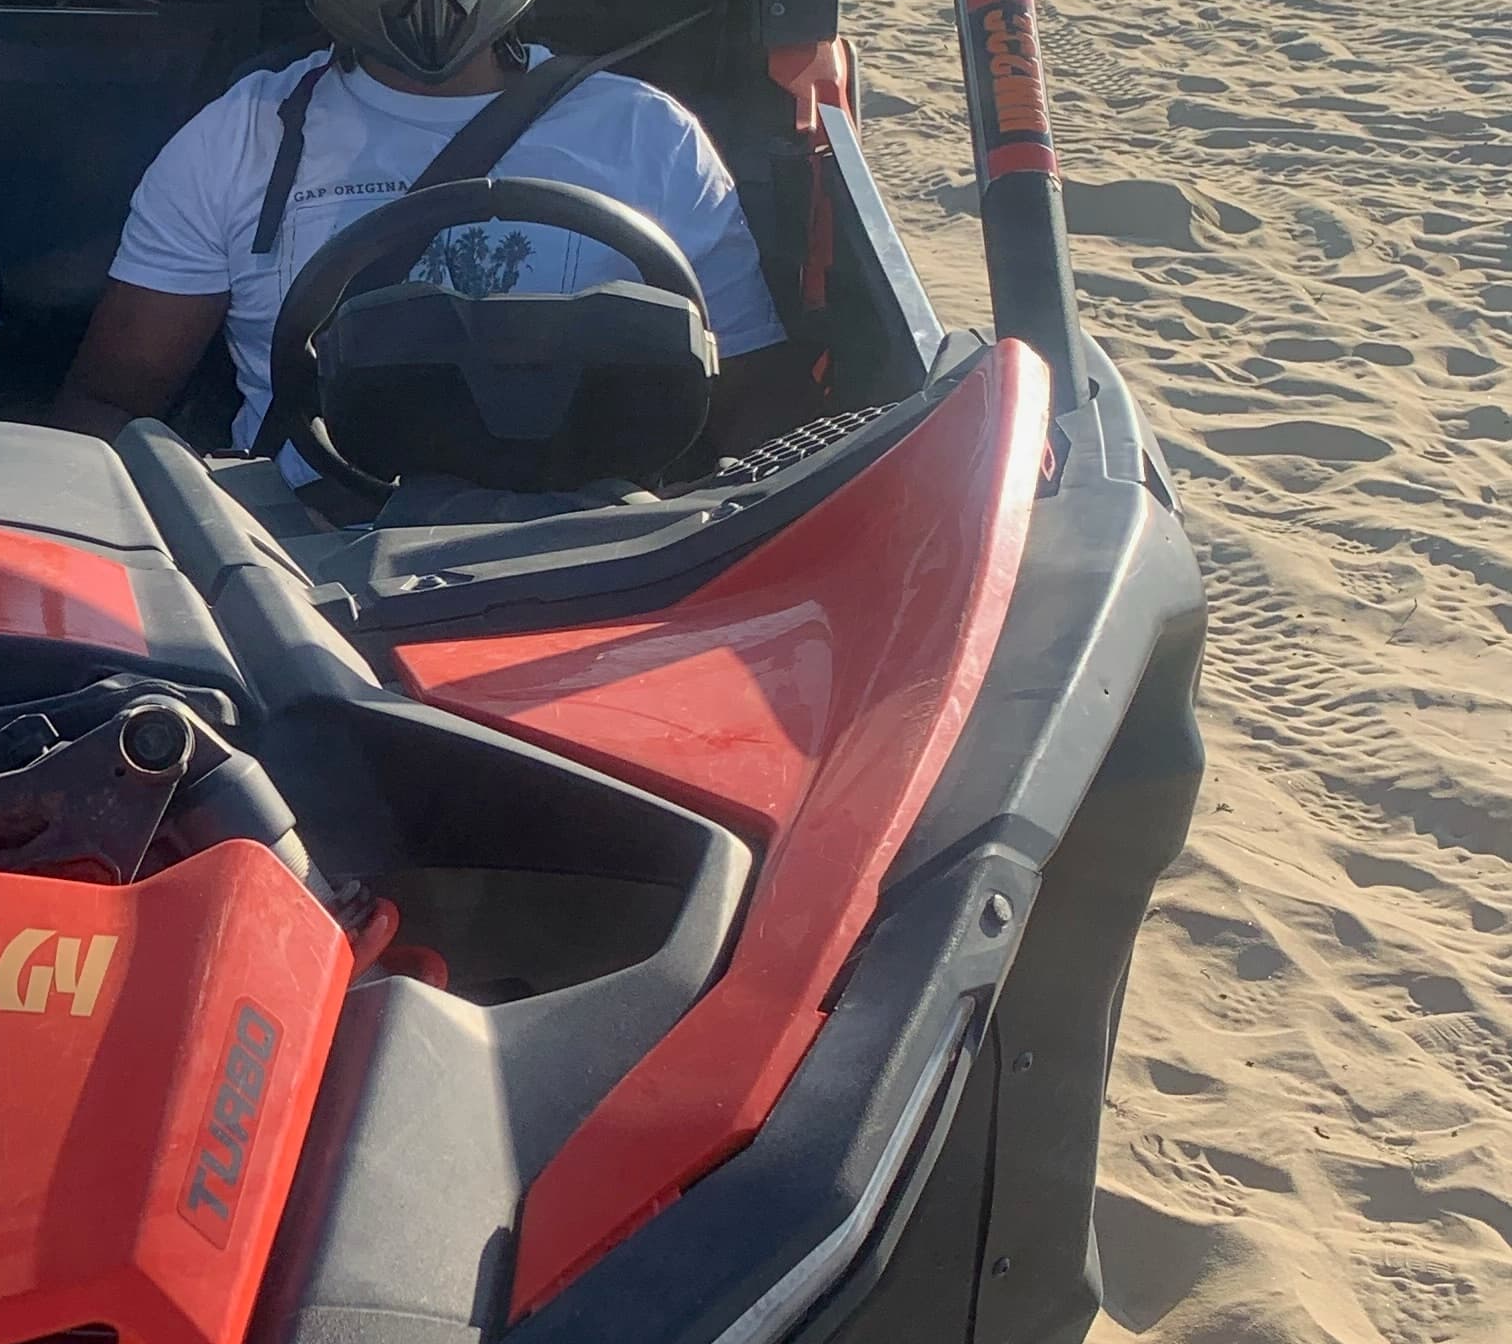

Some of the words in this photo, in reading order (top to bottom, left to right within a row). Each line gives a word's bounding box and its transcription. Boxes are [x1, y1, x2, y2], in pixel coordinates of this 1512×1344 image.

[294, 188, 327, 203] GAP
[335, 181, 409, 196] ORIGINA
[185, 1006, 281, 1223] TURBO
